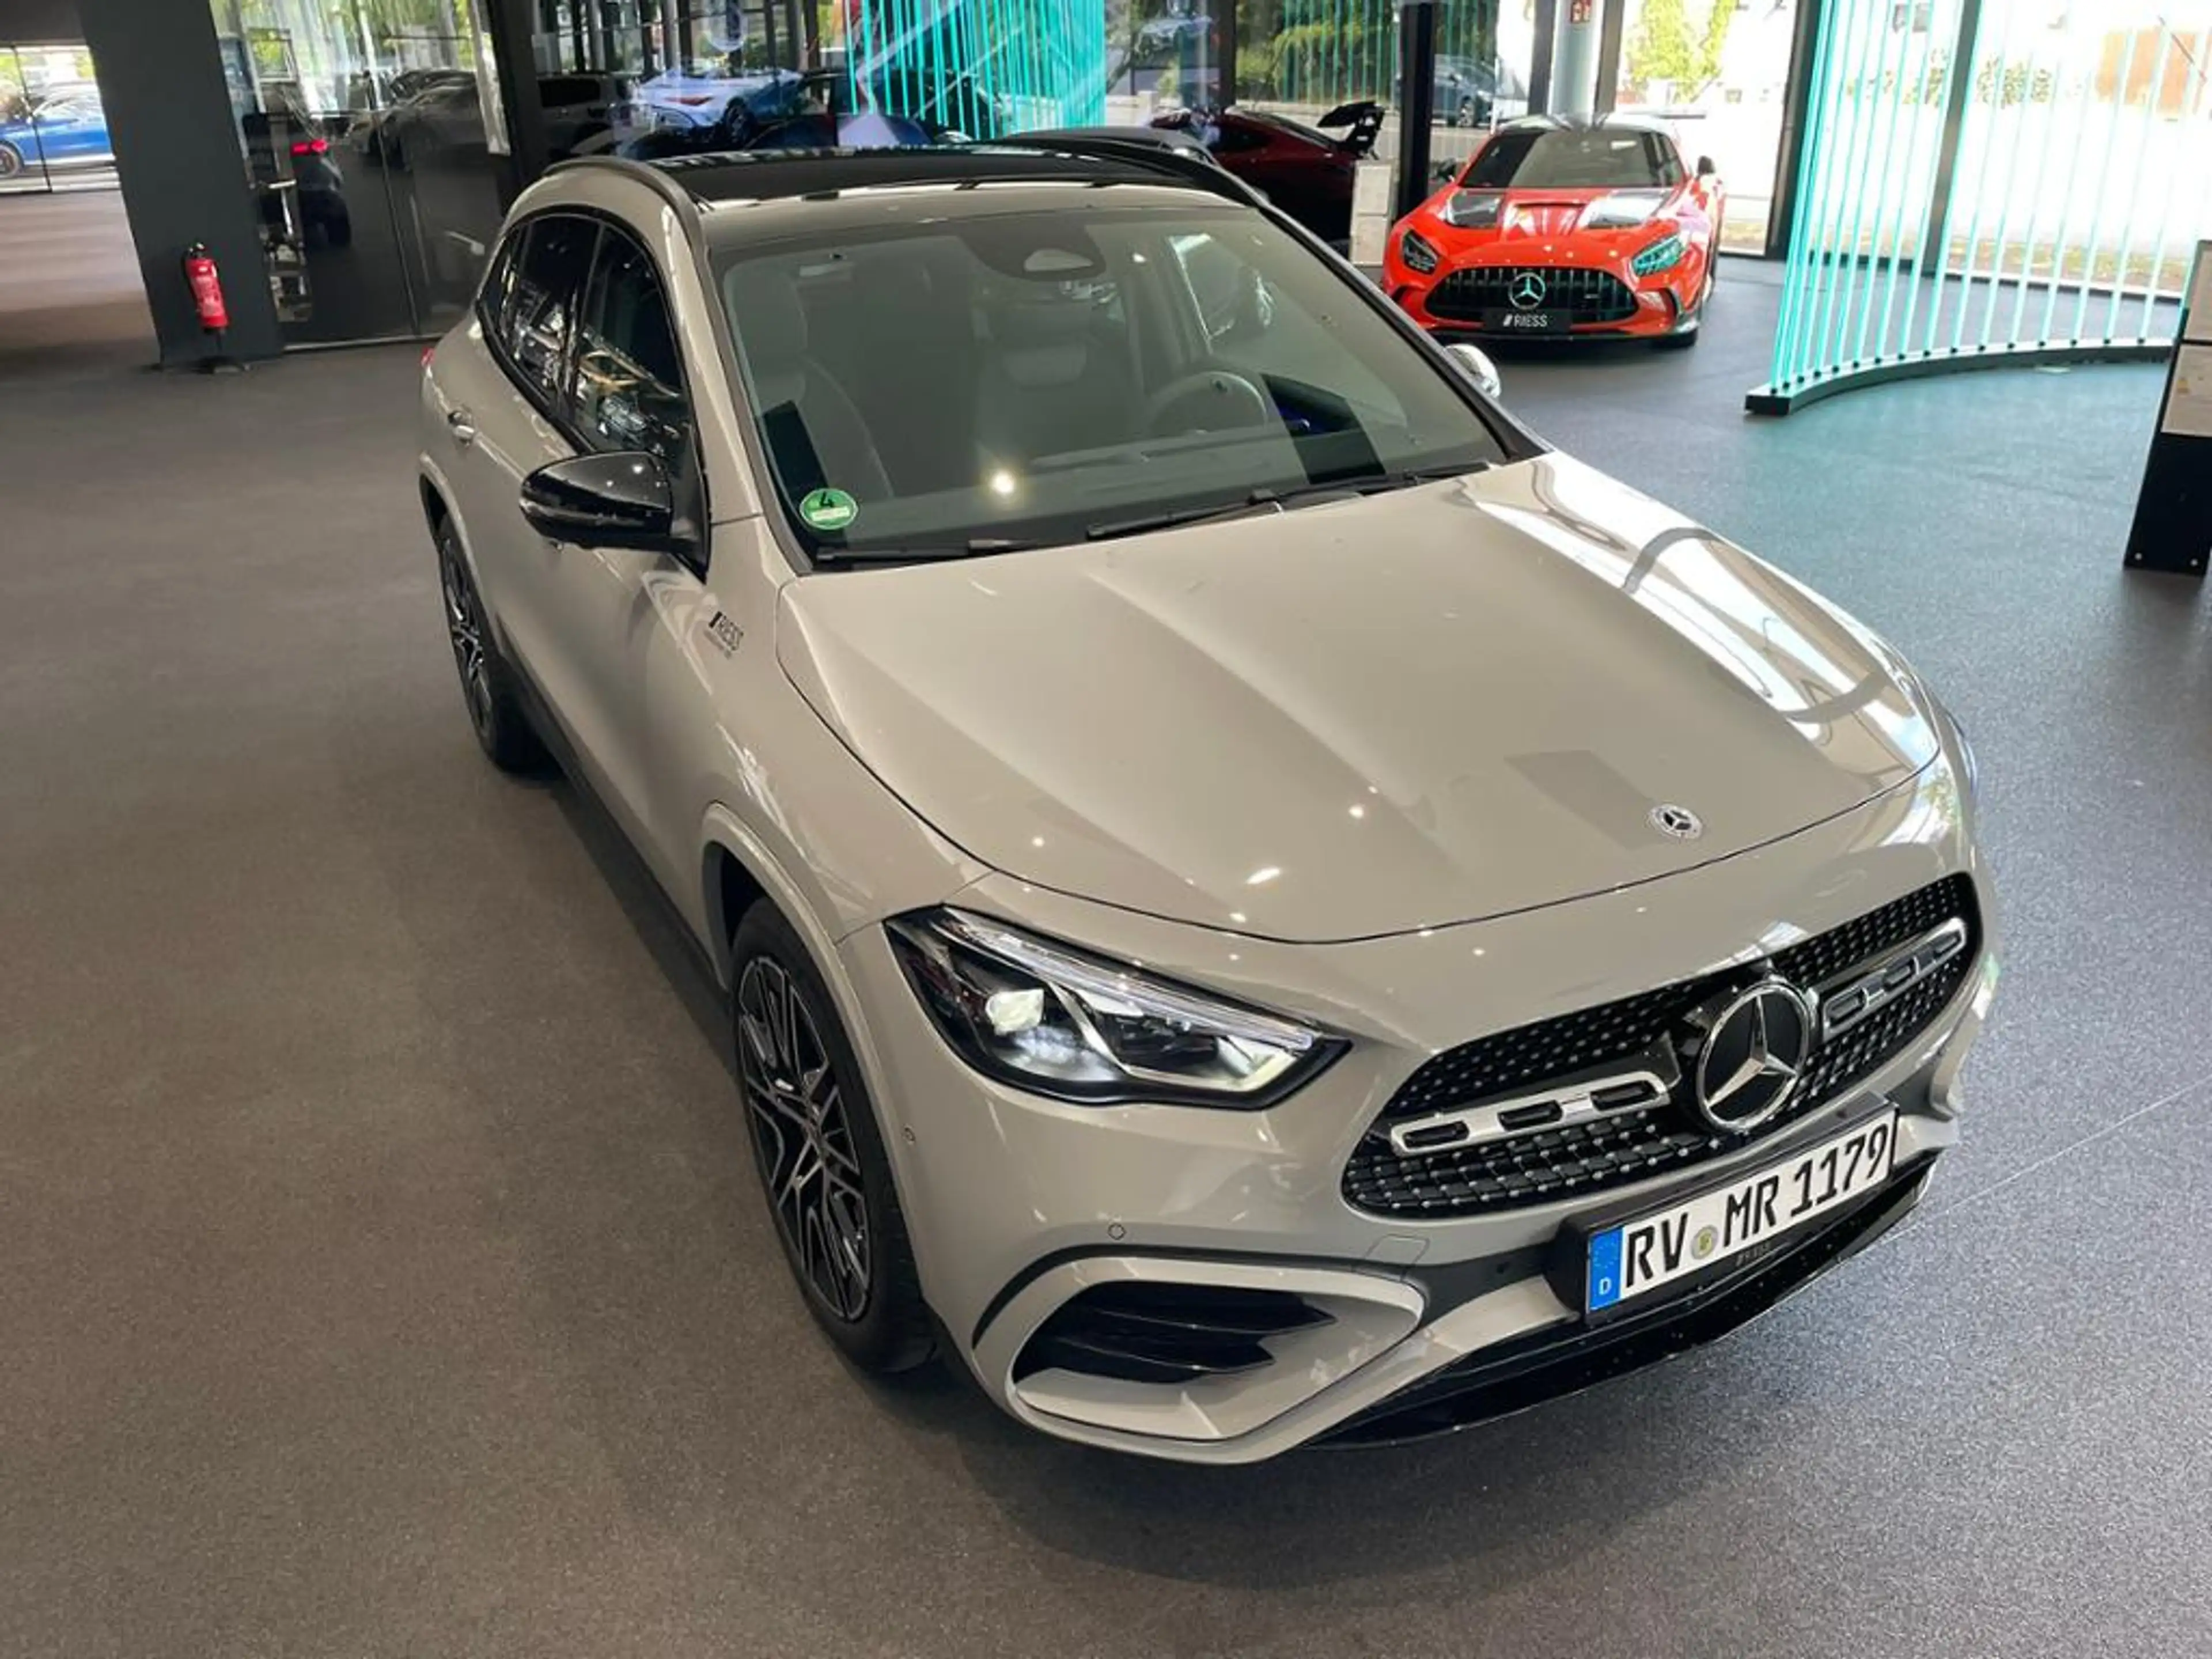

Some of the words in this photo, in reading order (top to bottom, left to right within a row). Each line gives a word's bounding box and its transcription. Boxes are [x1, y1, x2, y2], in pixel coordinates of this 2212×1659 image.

[1514, 314, 1548, 327] RIESS
[820, 491, 834, 507] 4
[1626, 1211, 1688, 1288] RV
[1724, 1175, 1779, 1247] MR
[1790, 1124, 1889, 1217] 1179
[1599, 1277, 1612, 1296] D
